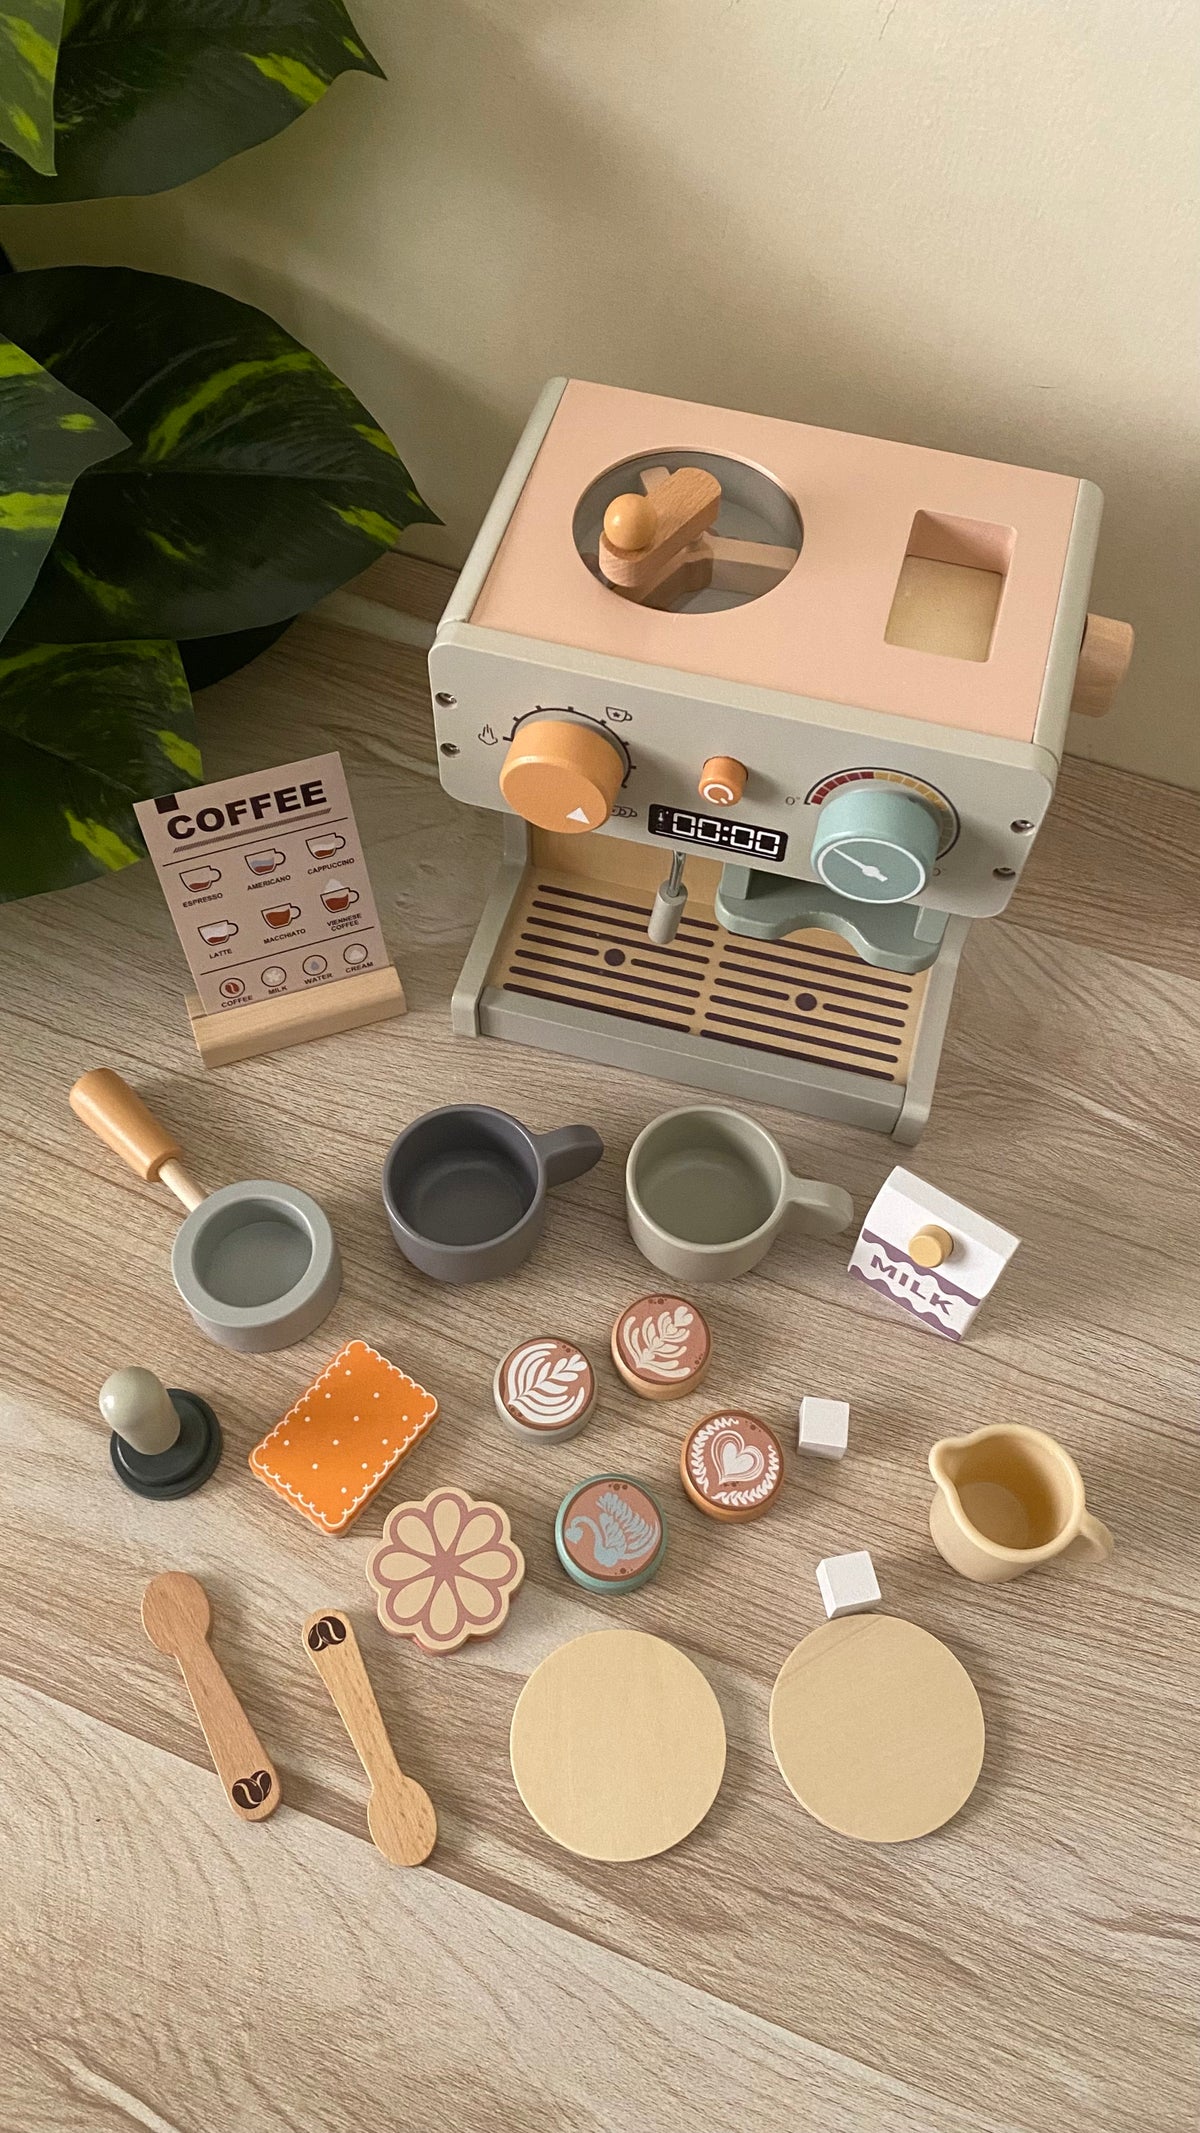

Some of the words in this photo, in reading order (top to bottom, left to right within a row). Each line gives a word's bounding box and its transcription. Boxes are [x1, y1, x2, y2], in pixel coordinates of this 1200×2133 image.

[166, 779, 328, 841] COFFEE
[672, 812, 780, 855] 00:00
[307, 858, 355, 875] CAPPUCCINO
[247, 875, 291, 891] AMERICANO
[182, 892, 224, 908] ESPRESSO
[326, 913, 362, 927] VIENNESE
[330, 920, 360, 932] COFFEE
[263, 928, 306, 944] MACCHIATO
[208, 948, 233, 960] LATTE
[345, 961, 374, 974] CREAM
[304, 972, 333, 985] WATER
[268, 985, 288, 995] MILK
[221, 995, 254, 1009] COFFEE
[870, 1254, 954, 1316] MILK
